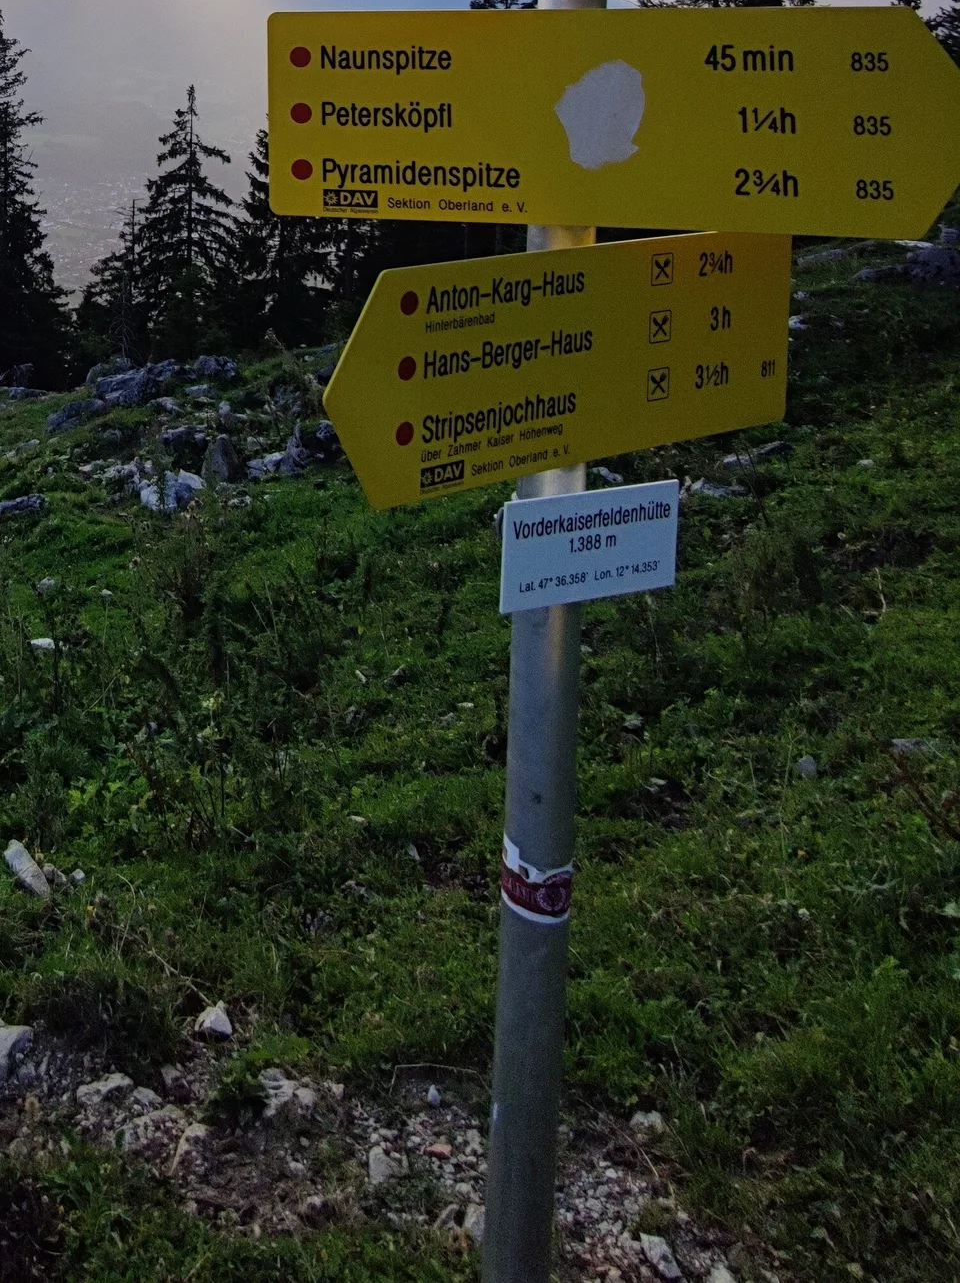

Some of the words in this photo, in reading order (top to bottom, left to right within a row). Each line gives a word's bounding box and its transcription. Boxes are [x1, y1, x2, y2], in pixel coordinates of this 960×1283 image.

[320, 45, 452, 75] Naunspitze
[705, 44, 737, 72] 45
[742, 45, 795, 72] min
[850, 52, 889, 72] 835
[321, 101, 453, 133] Petersköpfl
[853, 115, 892, 136] 835
[322, 158, 520, 192] Pyramidenspitze
[339, 191, 376, 206] DAV
[855, 179, 894, 201] 835
[387, 197, 431, 211] Sektion
[438, 198, 494, 213] Oberland
[426, 269, 585, 315] Anton-Karg-Haus
[425, 312, 495, 334] Hinterbärenbad
[423, 329, 593, 380] Hans-Berger-Haus
[760, 360, 776, 379] 811
[421, 390, 577, 445] Stripsenjochhaus
[420, 449, 442, 463] über
[447, 440, 482, 458] Zahmer
[487, 433, 514, 448] Kaiser
[519, 423, 563, 441] Höhenweg
[434, 462, 463, 484] DAV
[471, 459, 504, 477] Sektion
[509, 449, 548, 468] Oberland
[513, 501, 671, 540] Vorderkaiserfeldenhütte
[569, 534, 602, 554] 1.388
[605, 534, 617, 548] m
[519, 581, 536, 593] Lat.
[594, 568, 614, 581] Lon.
